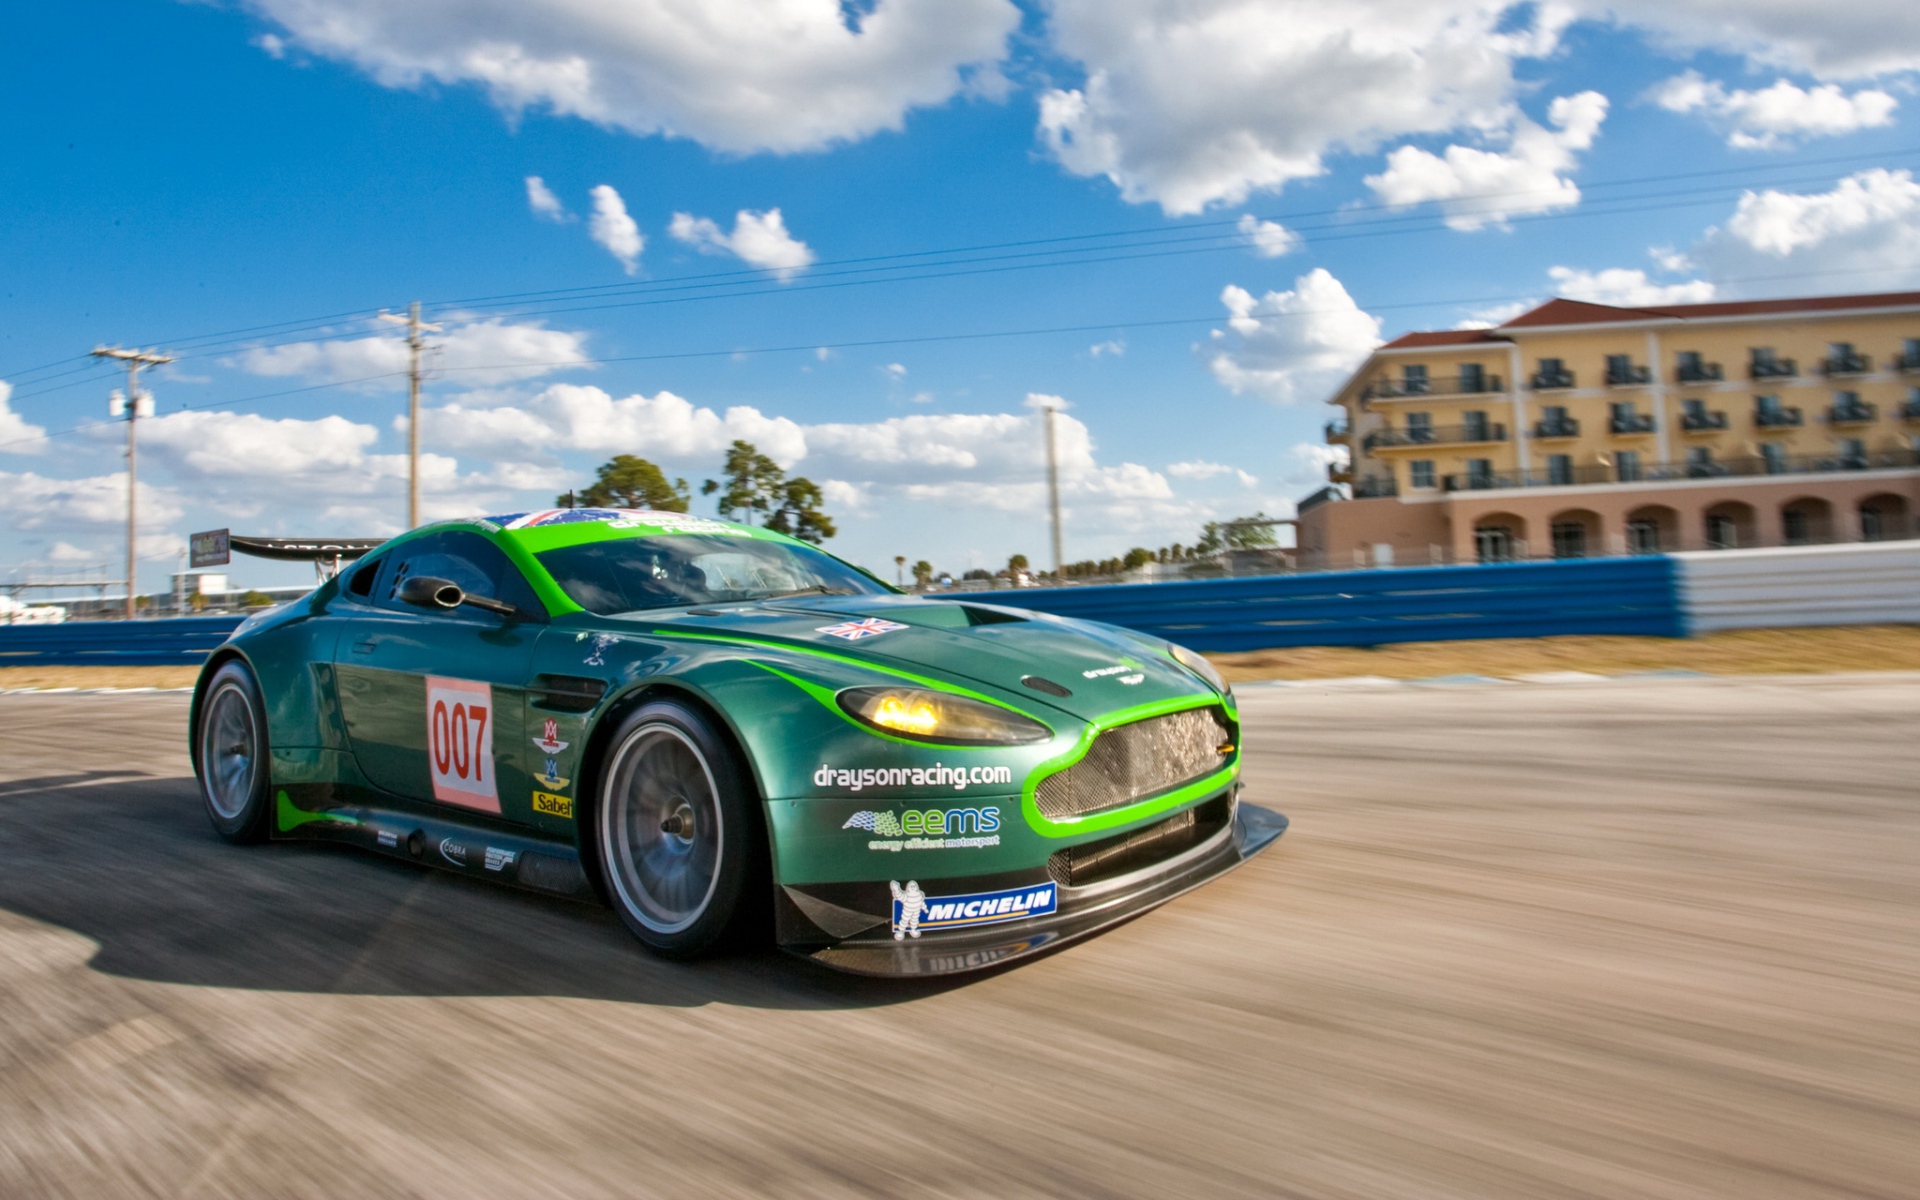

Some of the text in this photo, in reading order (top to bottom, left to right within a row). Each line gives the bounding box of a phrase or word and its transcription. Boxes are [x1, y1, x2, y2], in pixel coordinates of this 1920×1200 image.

[433, 700, 487, 782] 007
[814, 762, 1011, 791] draysonracing.com
[538, 794, 573, 816] Sabel
[901, 806, 1000, 835] eems
[868, 835, 1000, 852] energy efficient motorsport
[927, 889, 1052, 921] MICHELIN
